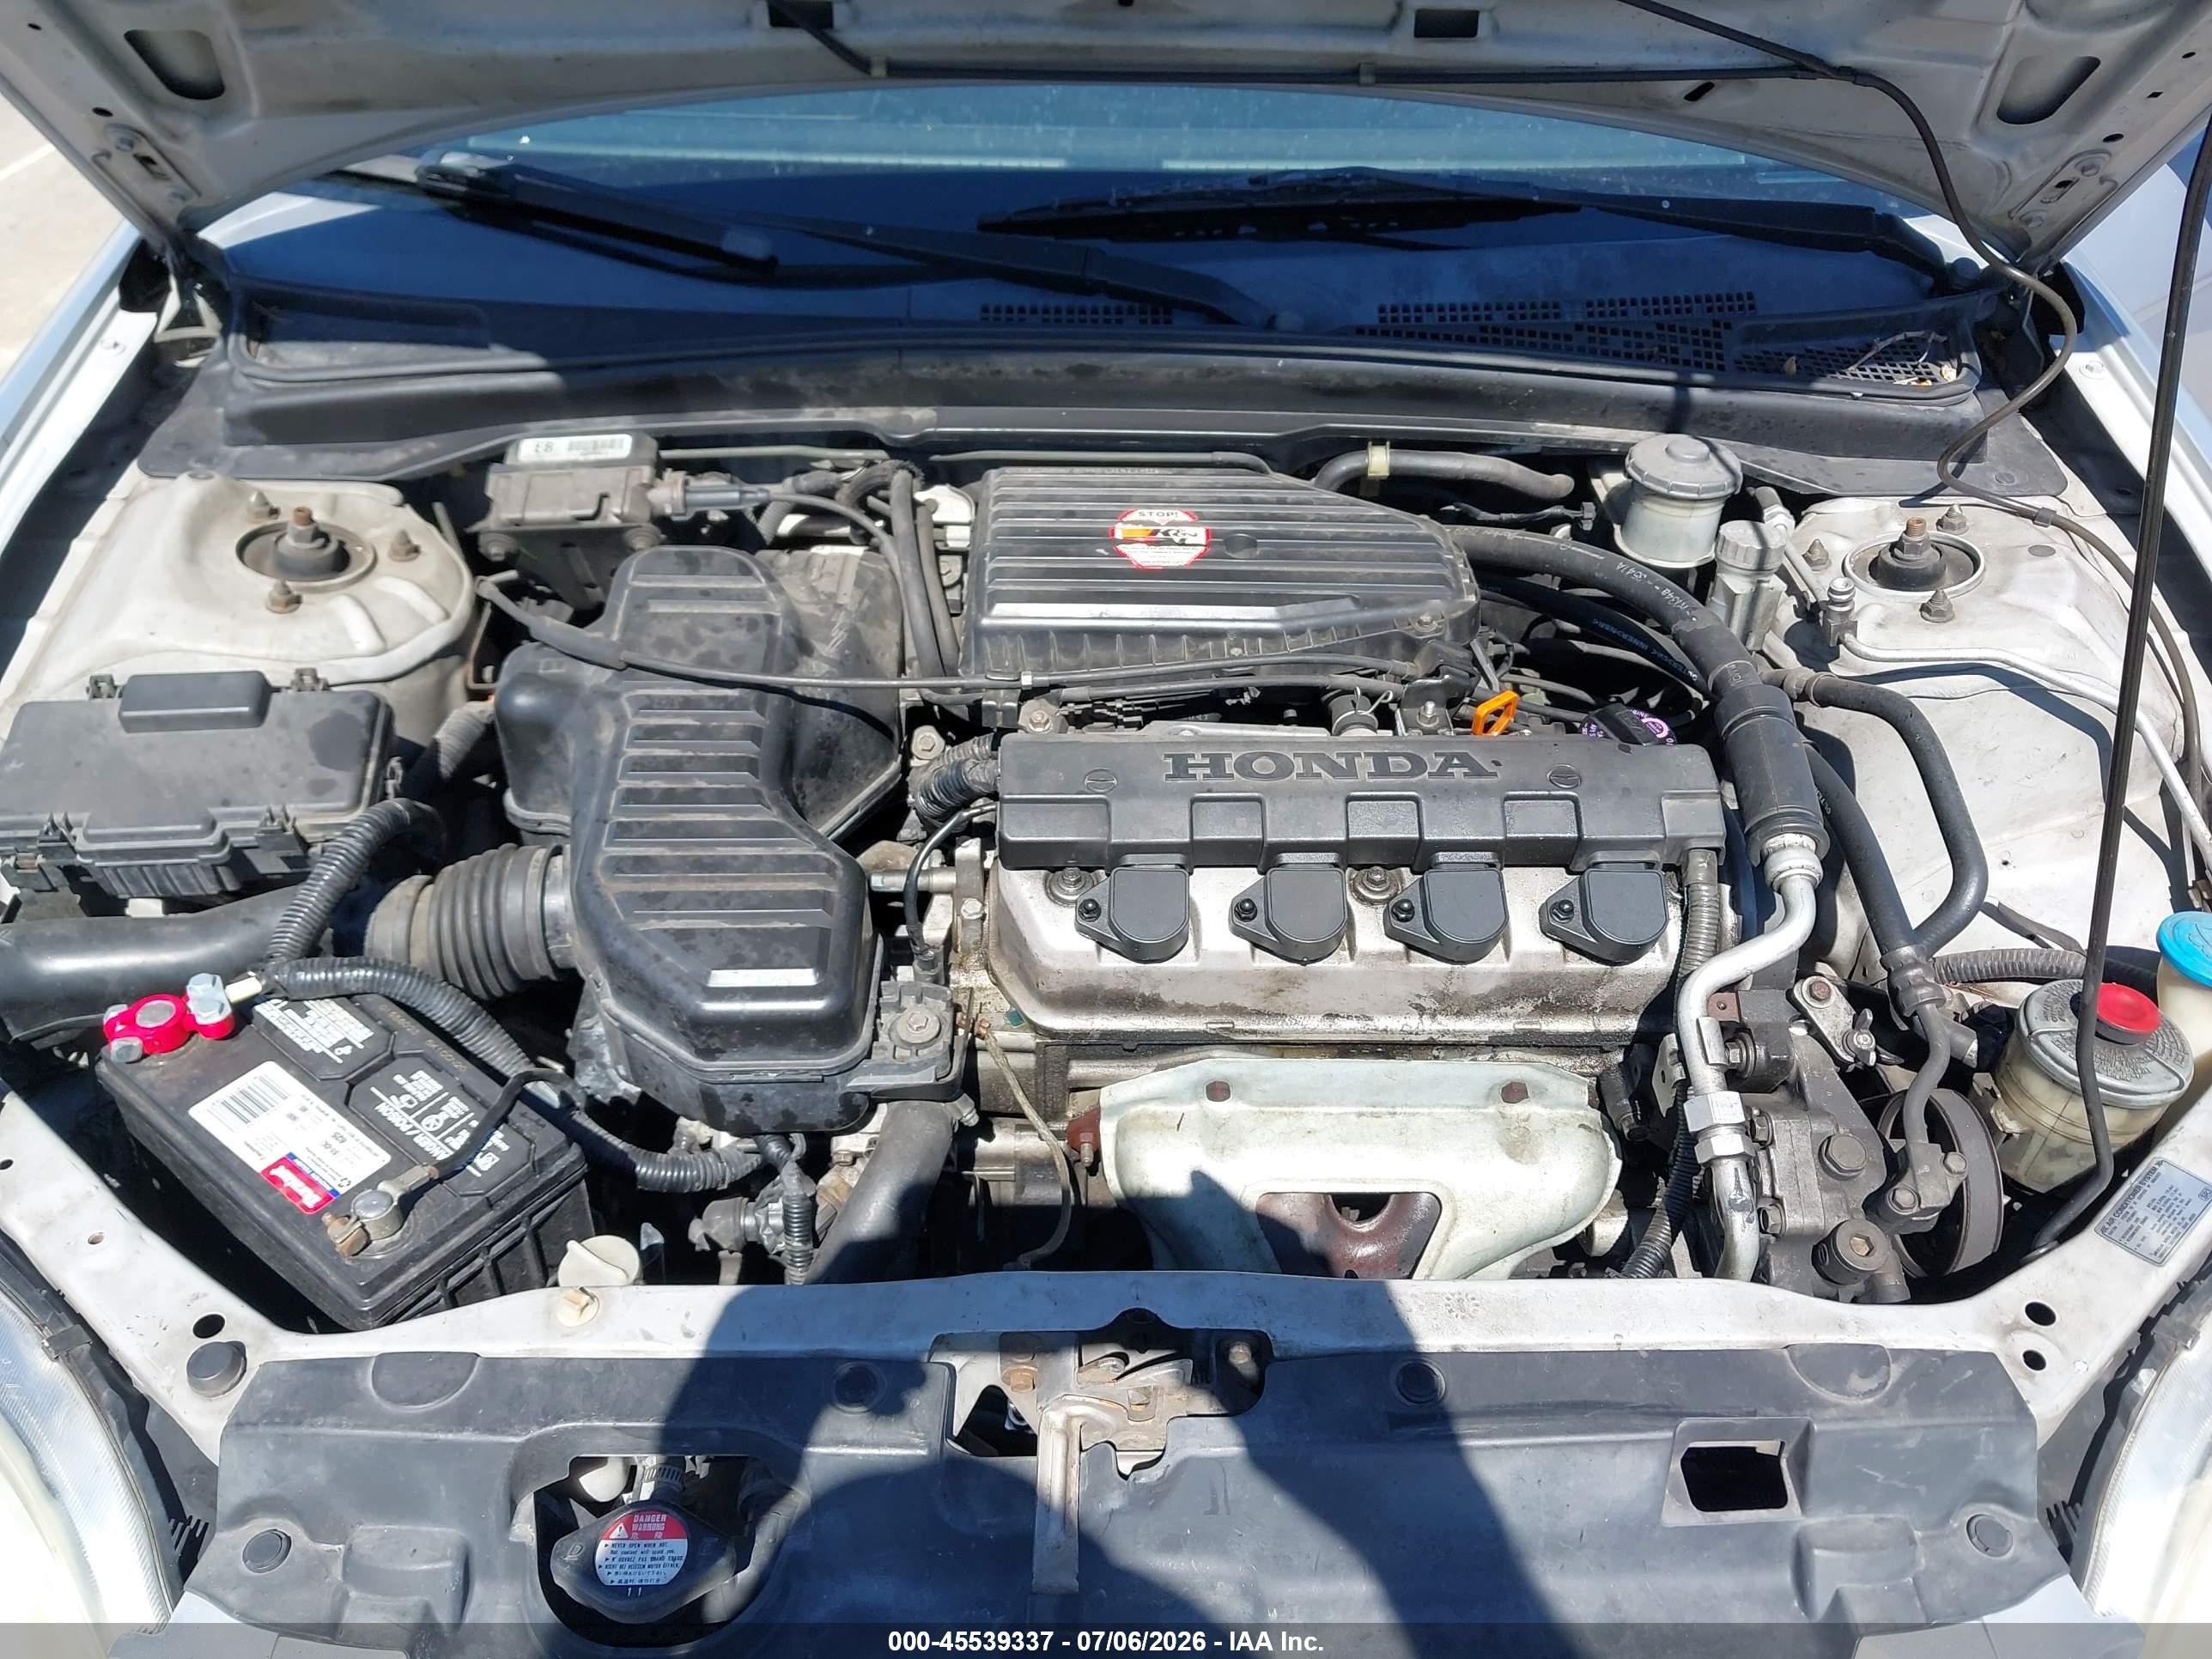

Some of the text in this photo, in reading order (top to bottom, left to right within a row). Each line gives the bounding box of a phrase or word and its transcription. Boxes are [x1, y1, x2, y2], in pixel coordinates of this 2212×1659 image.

[1164, 750, 1499, 781] HONDA
[374, 1102, 413, 1133] POISON
[413, 1132, 453, 1160] ANGER
[633, 1514, 667, 1523] DANGER
